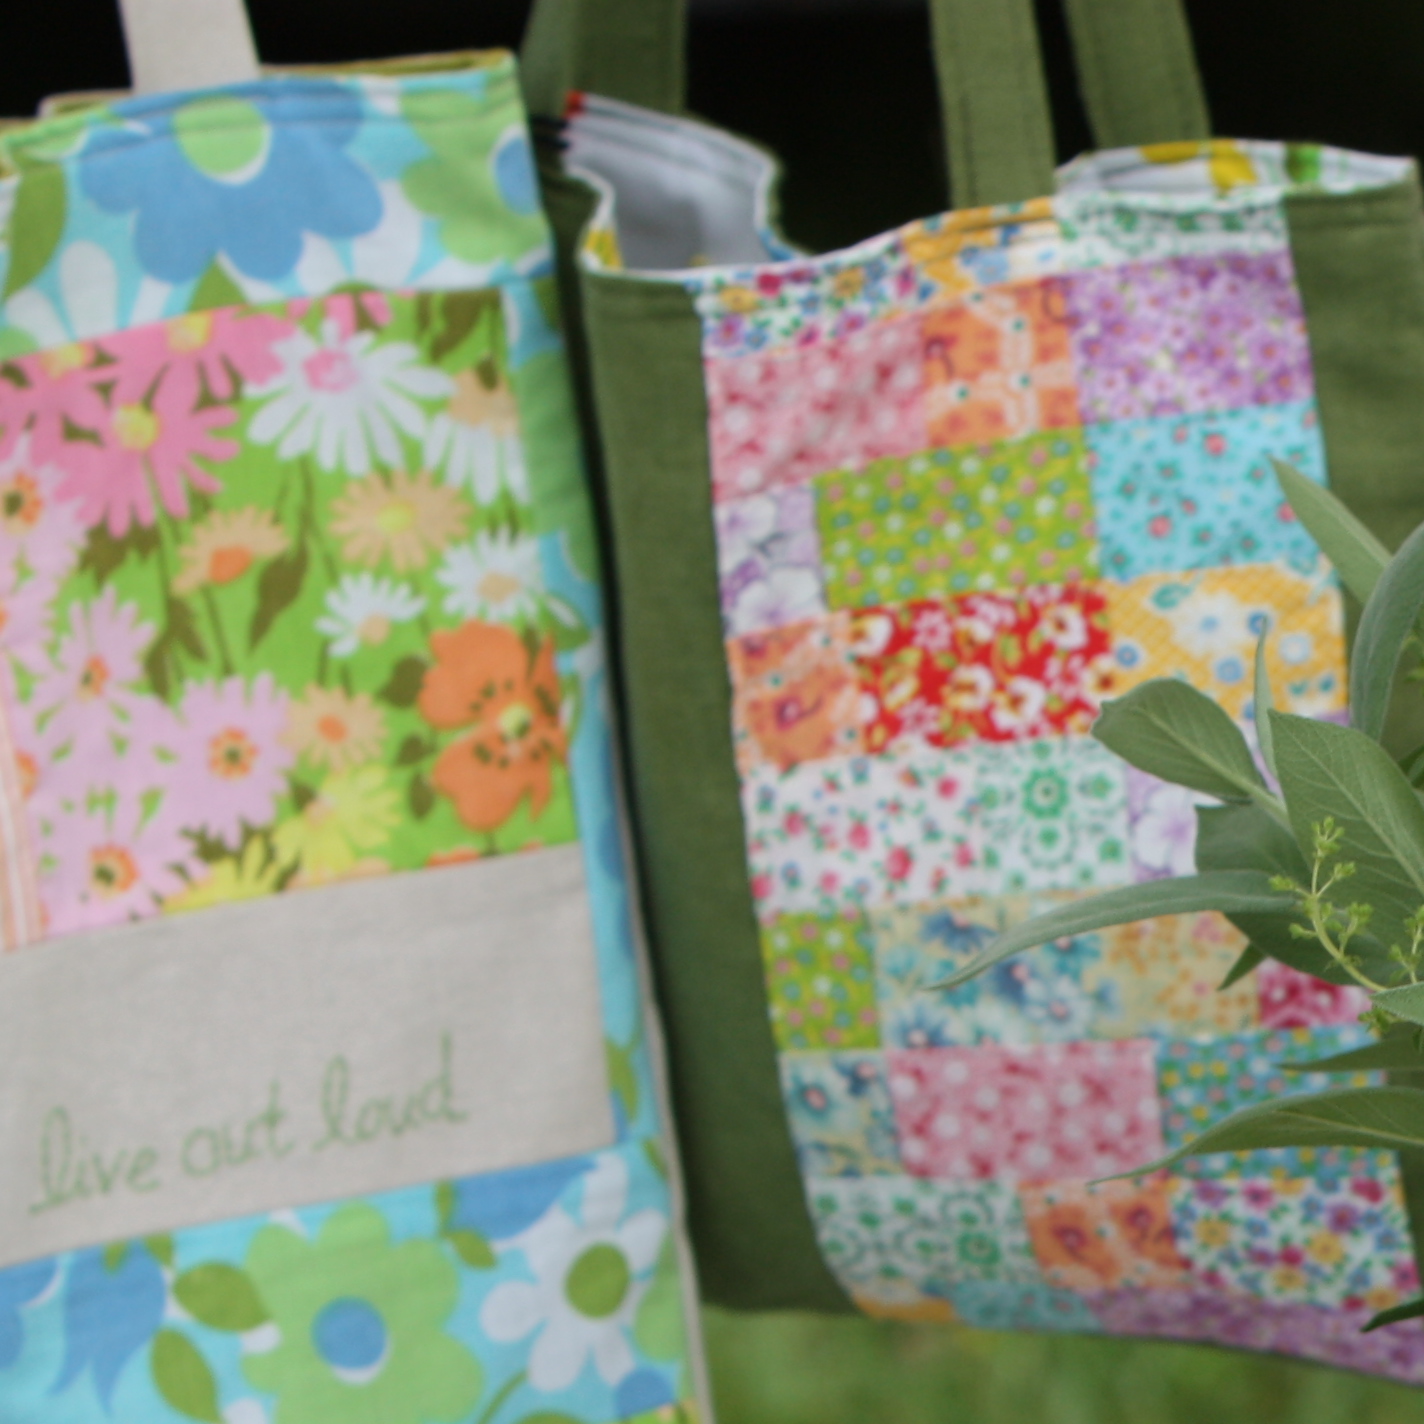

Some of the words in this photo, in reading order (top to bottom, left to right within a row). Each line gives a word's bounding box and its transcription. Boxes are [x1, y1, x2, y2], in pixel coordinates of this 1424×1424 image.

[29, 1105, 163, 1215] live
[180, 1077, 296, 1177] out
[312, 1031, 469, 1152] loud
